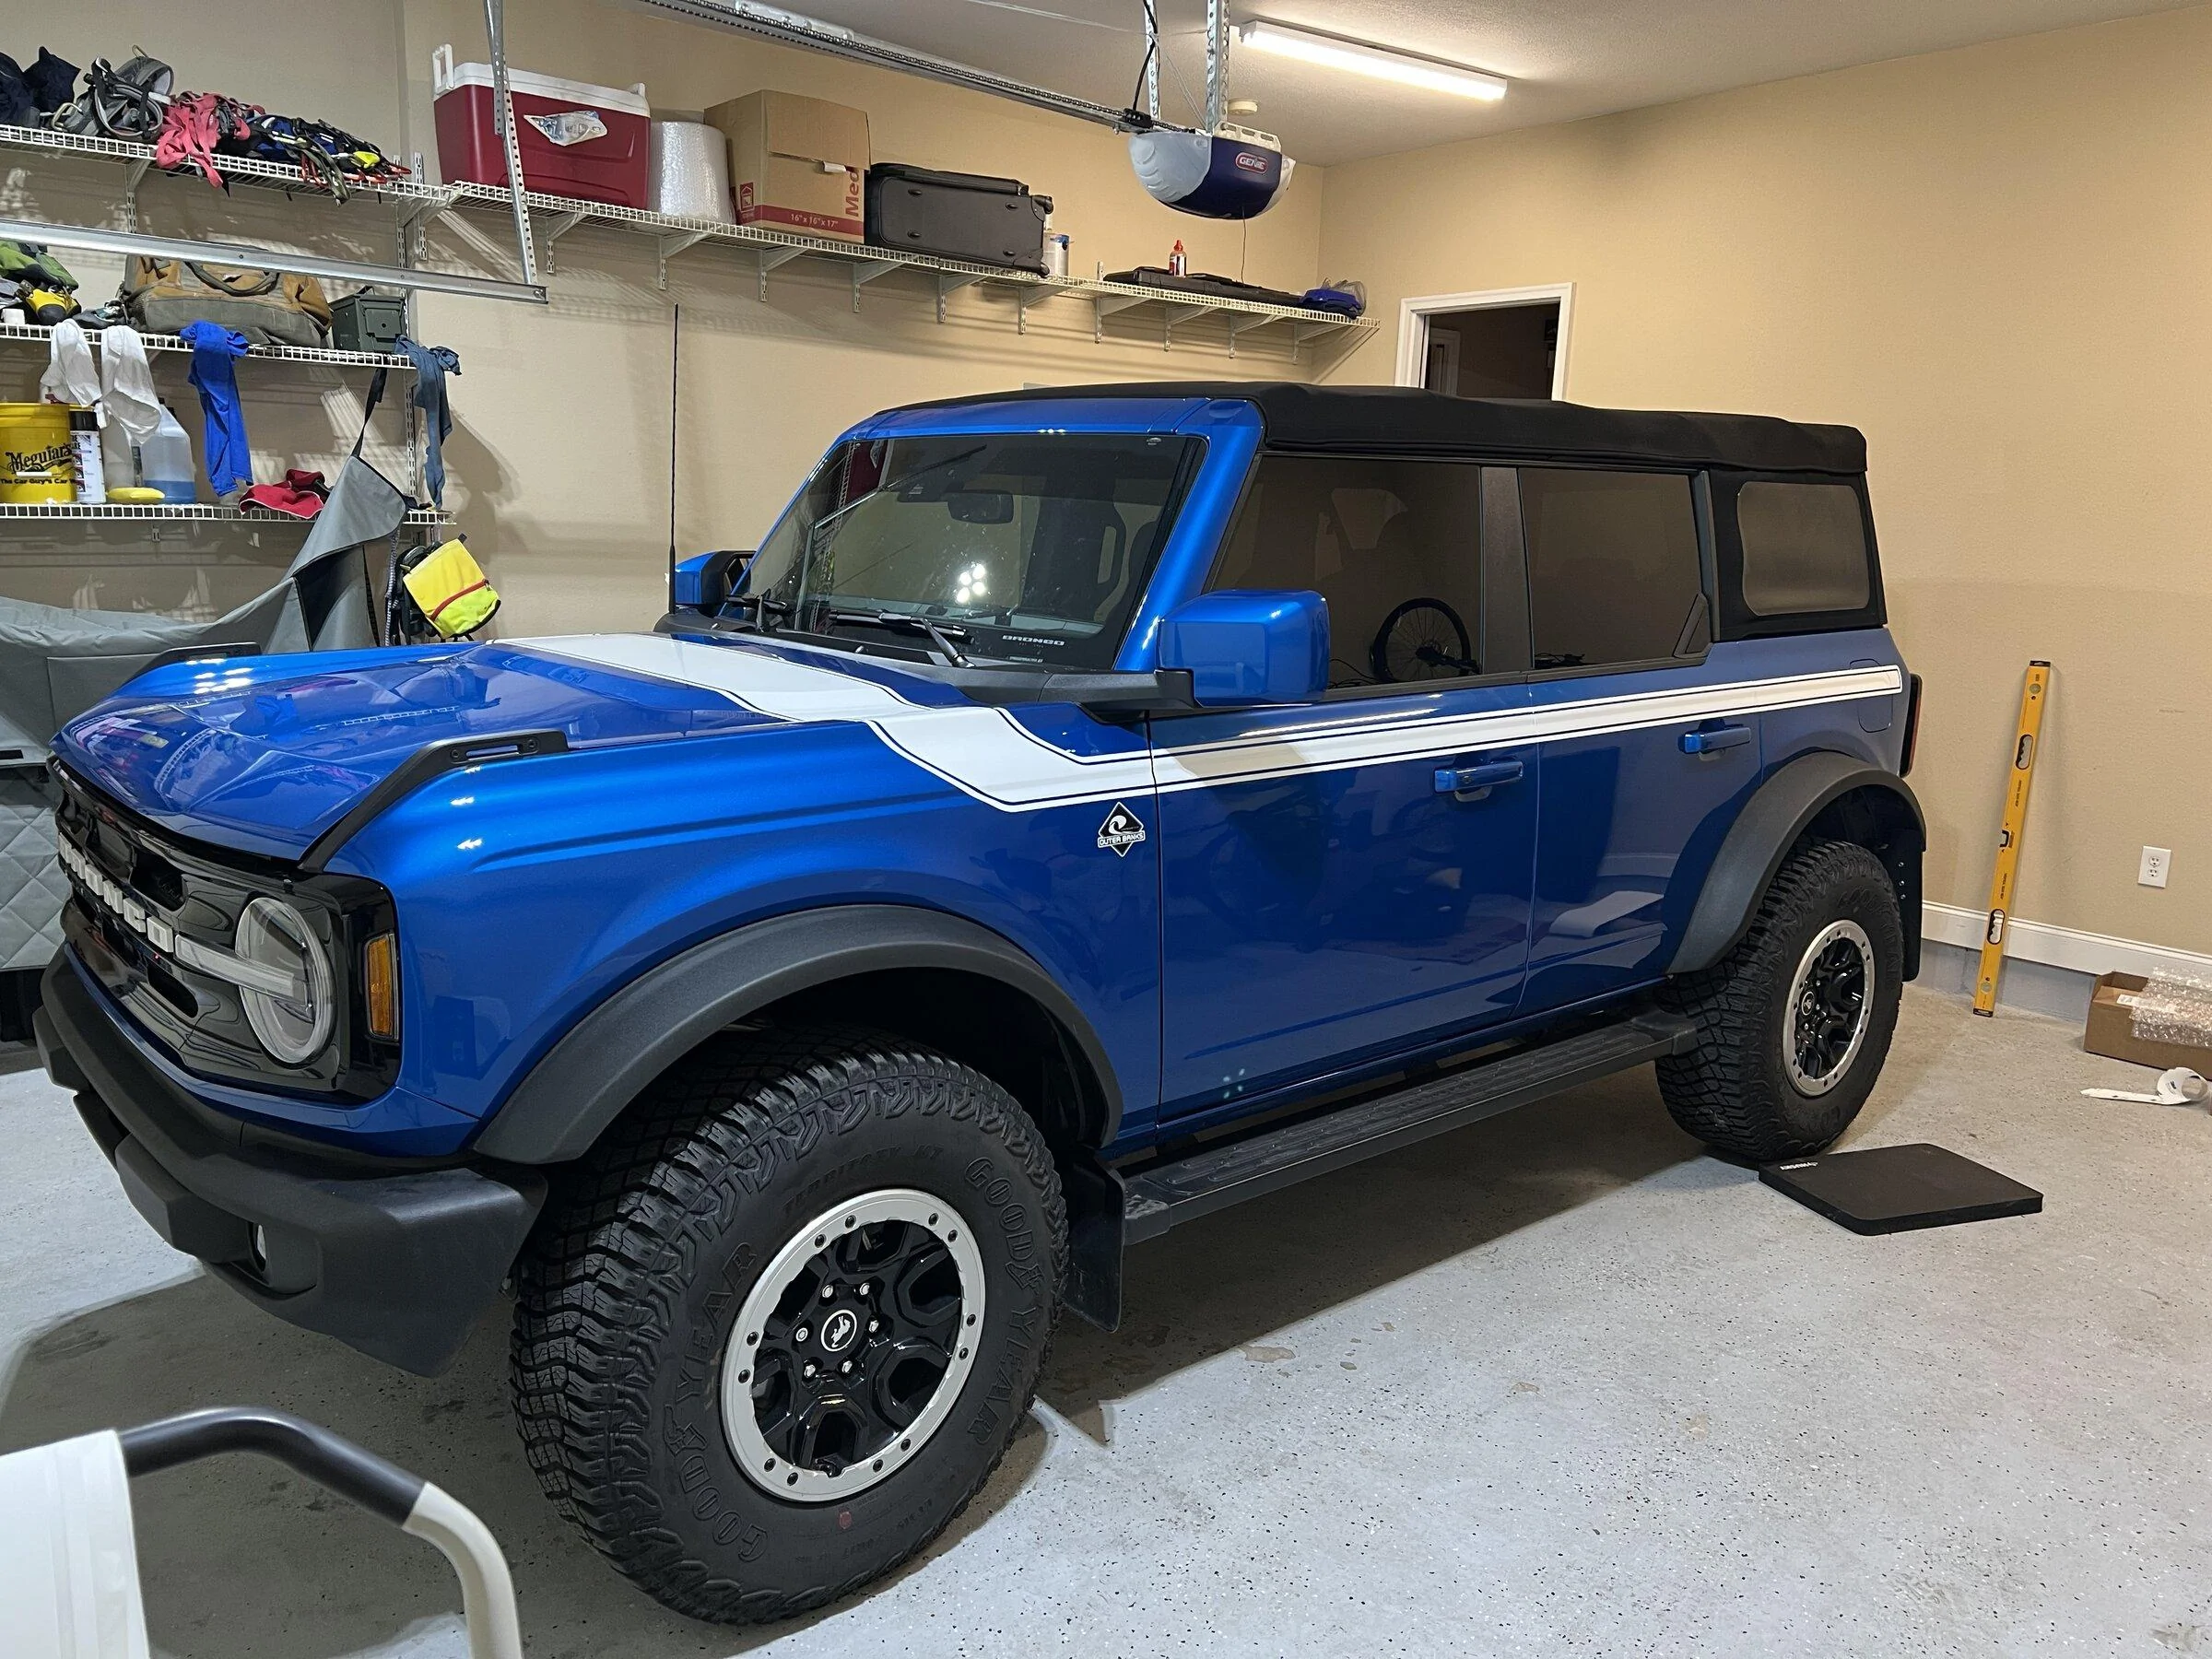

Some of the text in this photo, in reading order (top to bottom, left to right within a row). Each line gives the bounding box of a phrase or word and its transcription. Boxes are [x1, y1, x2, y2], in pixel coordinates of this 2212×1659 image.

[1240, 156, 1265, 170] GENIE
[791, 213, 803, 222] 16"
[6, 442, 73, 474] Meguiar's
[1002, 634, 1065, 646] BRONCO
[1100, 832, 1144, 846] OUTER BANKS
[57, 831, 174, 953] BRONCO
